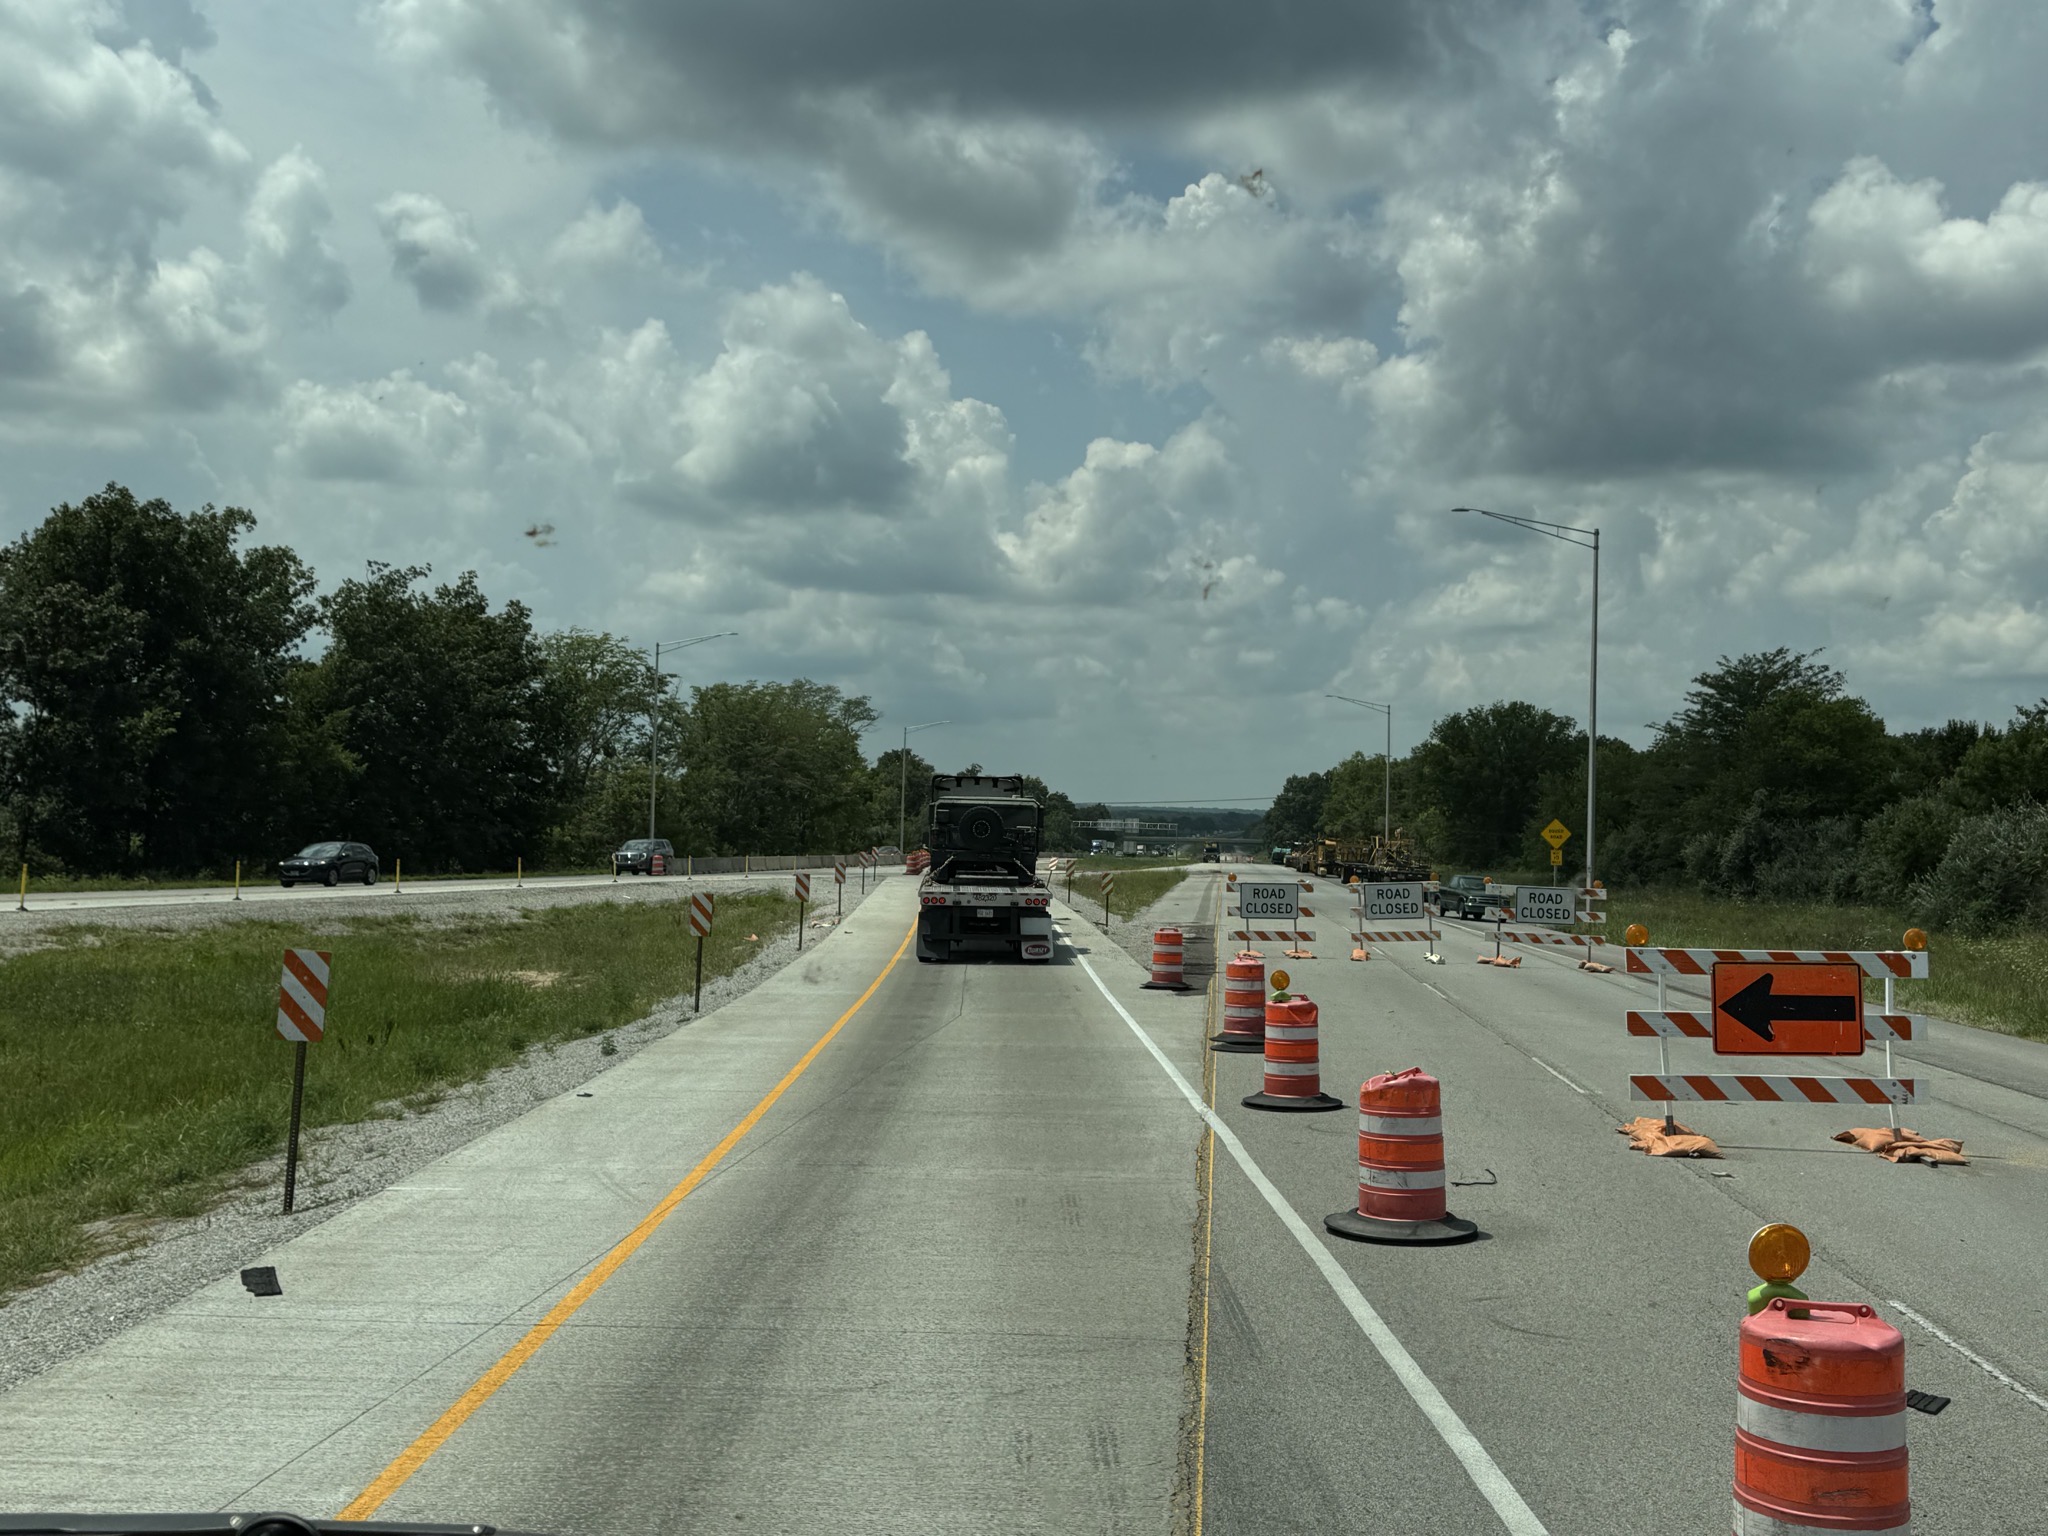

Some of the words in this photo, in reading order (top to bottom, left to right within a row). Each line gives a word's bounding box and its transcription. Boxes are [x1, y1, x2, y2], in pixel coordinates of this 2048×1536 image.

[1253, 888, 1286, 899] ROAD
[1377, 888, 1410, 899] ROAD
[1529, 893, 1563, 904] ROAD
[1246, 903, 1293, 914] CLOSED
[1370, 903, 1419, 914] CLOSED
[1521, 907, 1570, 920] CLOSED
